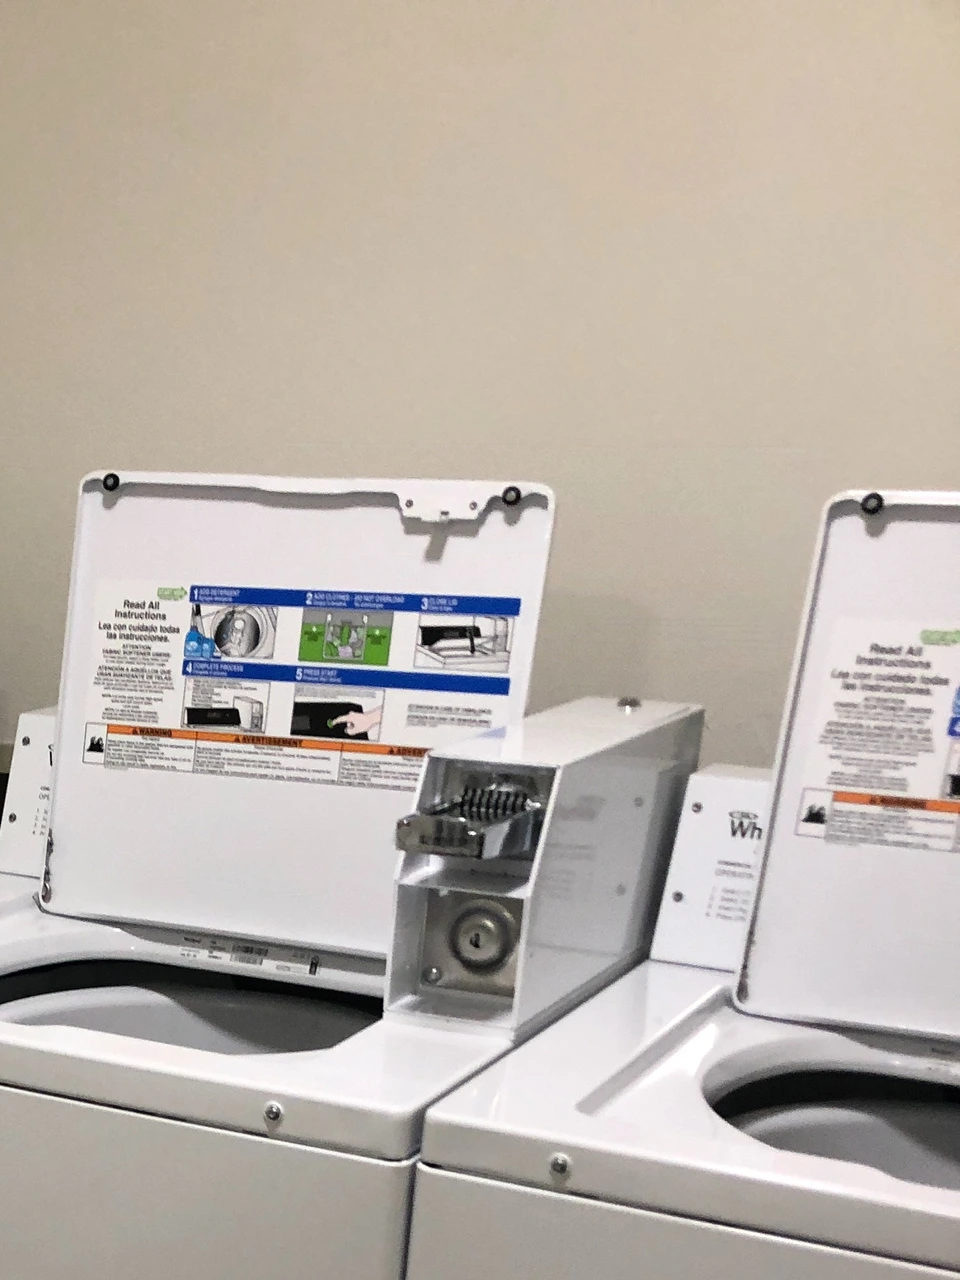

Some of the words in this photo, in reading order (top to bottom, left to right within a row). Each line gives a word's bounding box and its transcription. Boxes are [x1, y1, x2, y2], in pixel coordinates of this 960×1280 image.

[194, 588, 199, 600] 1
[306, 592, 313, 605] 2
[123, 599, 146, 611] Read
[148, 601, 160, 611] All
[421, 597, 429, 610] 3
[115, 609, 167, 621] Instructions
[98, 621, 111, 631] Lea
[113, 623, 127, 632] con
[129, 623, 158, 634] cuidado
[160, 625, 180, 634] todas
[106, 631, 117, 640] las
[119, 632, 170, 643] instrucciones.
[870, 644, 902, 655] Read
[186, 662, 193, 673] 4
[856, 655, 931, 670] Instructions
[295, 668, 303, 681] 5
[139, 728, 173, 737] WARNING
[242, 736, 303, 748] AVERTISSEMENT
